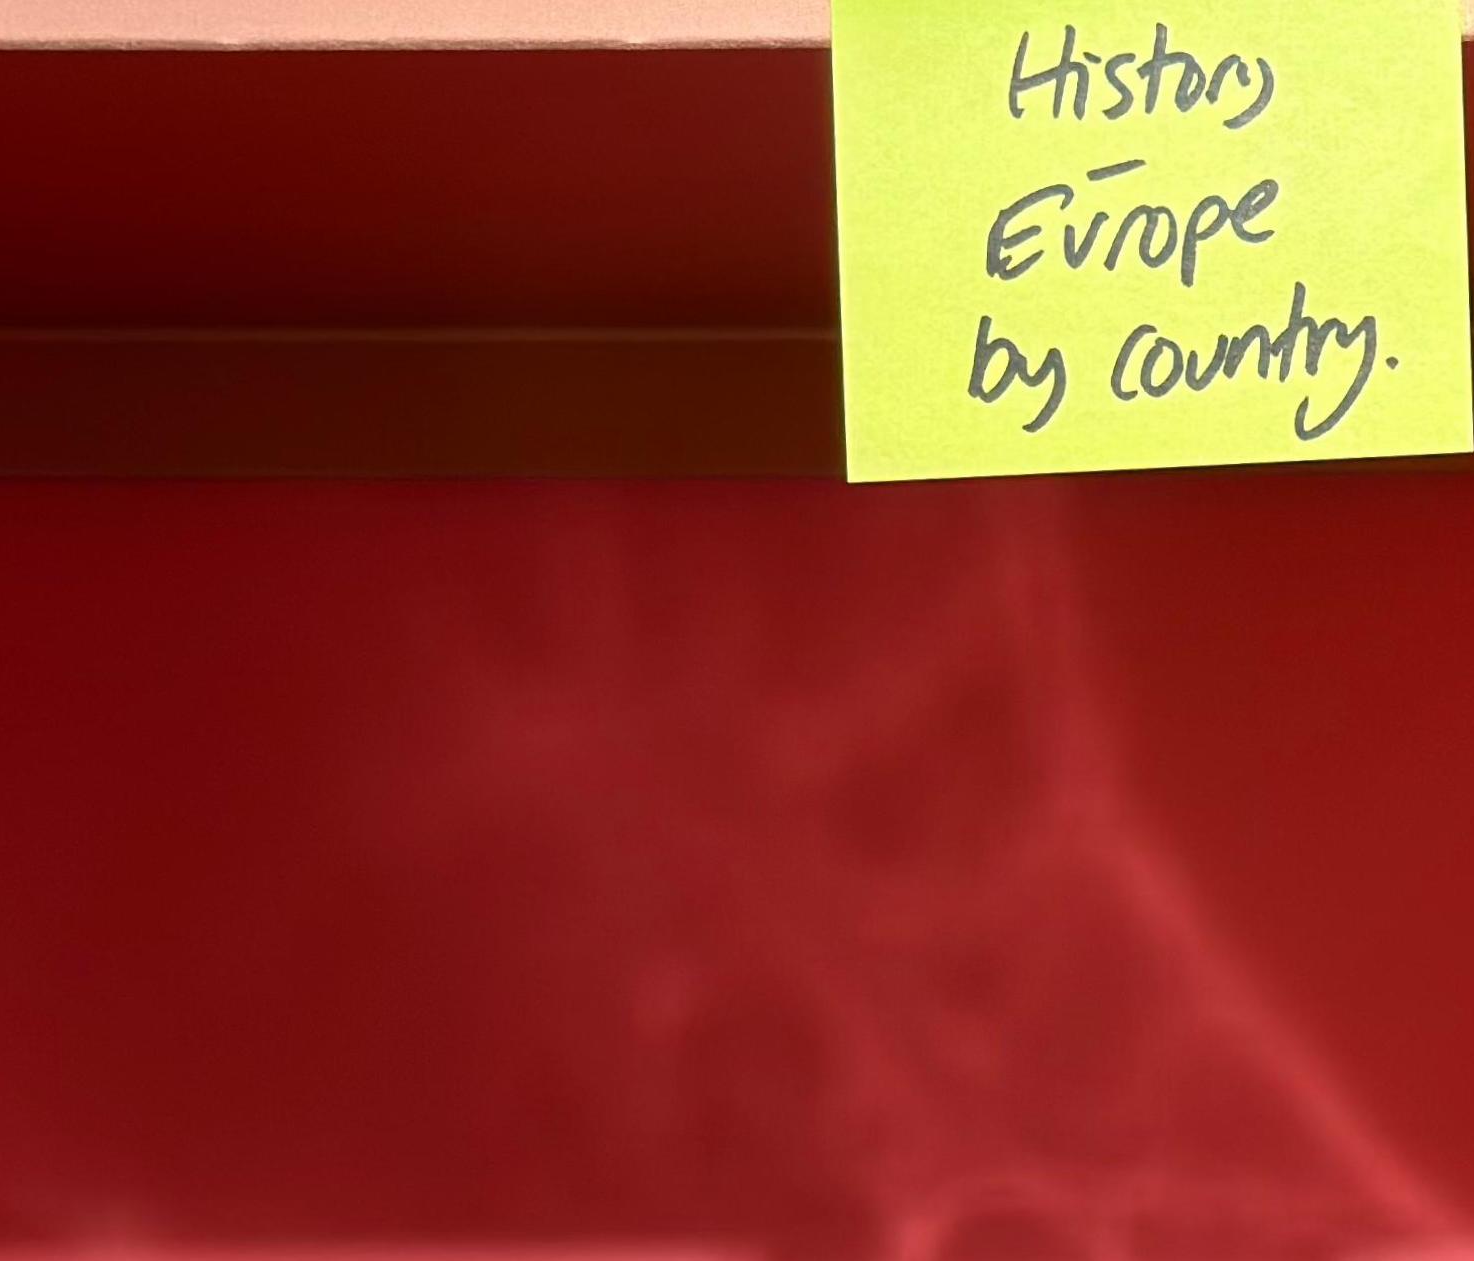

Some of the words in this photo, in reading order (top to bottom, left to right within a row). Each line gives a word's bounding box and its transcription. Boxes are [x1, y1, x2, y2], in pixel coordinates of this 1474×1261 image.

[1007, 22, 1275, 130] History
[985, 178, 1280, 289] Europe
[966, 314, 1068, 434] by
[1110, 280, 1400, 442] country.
